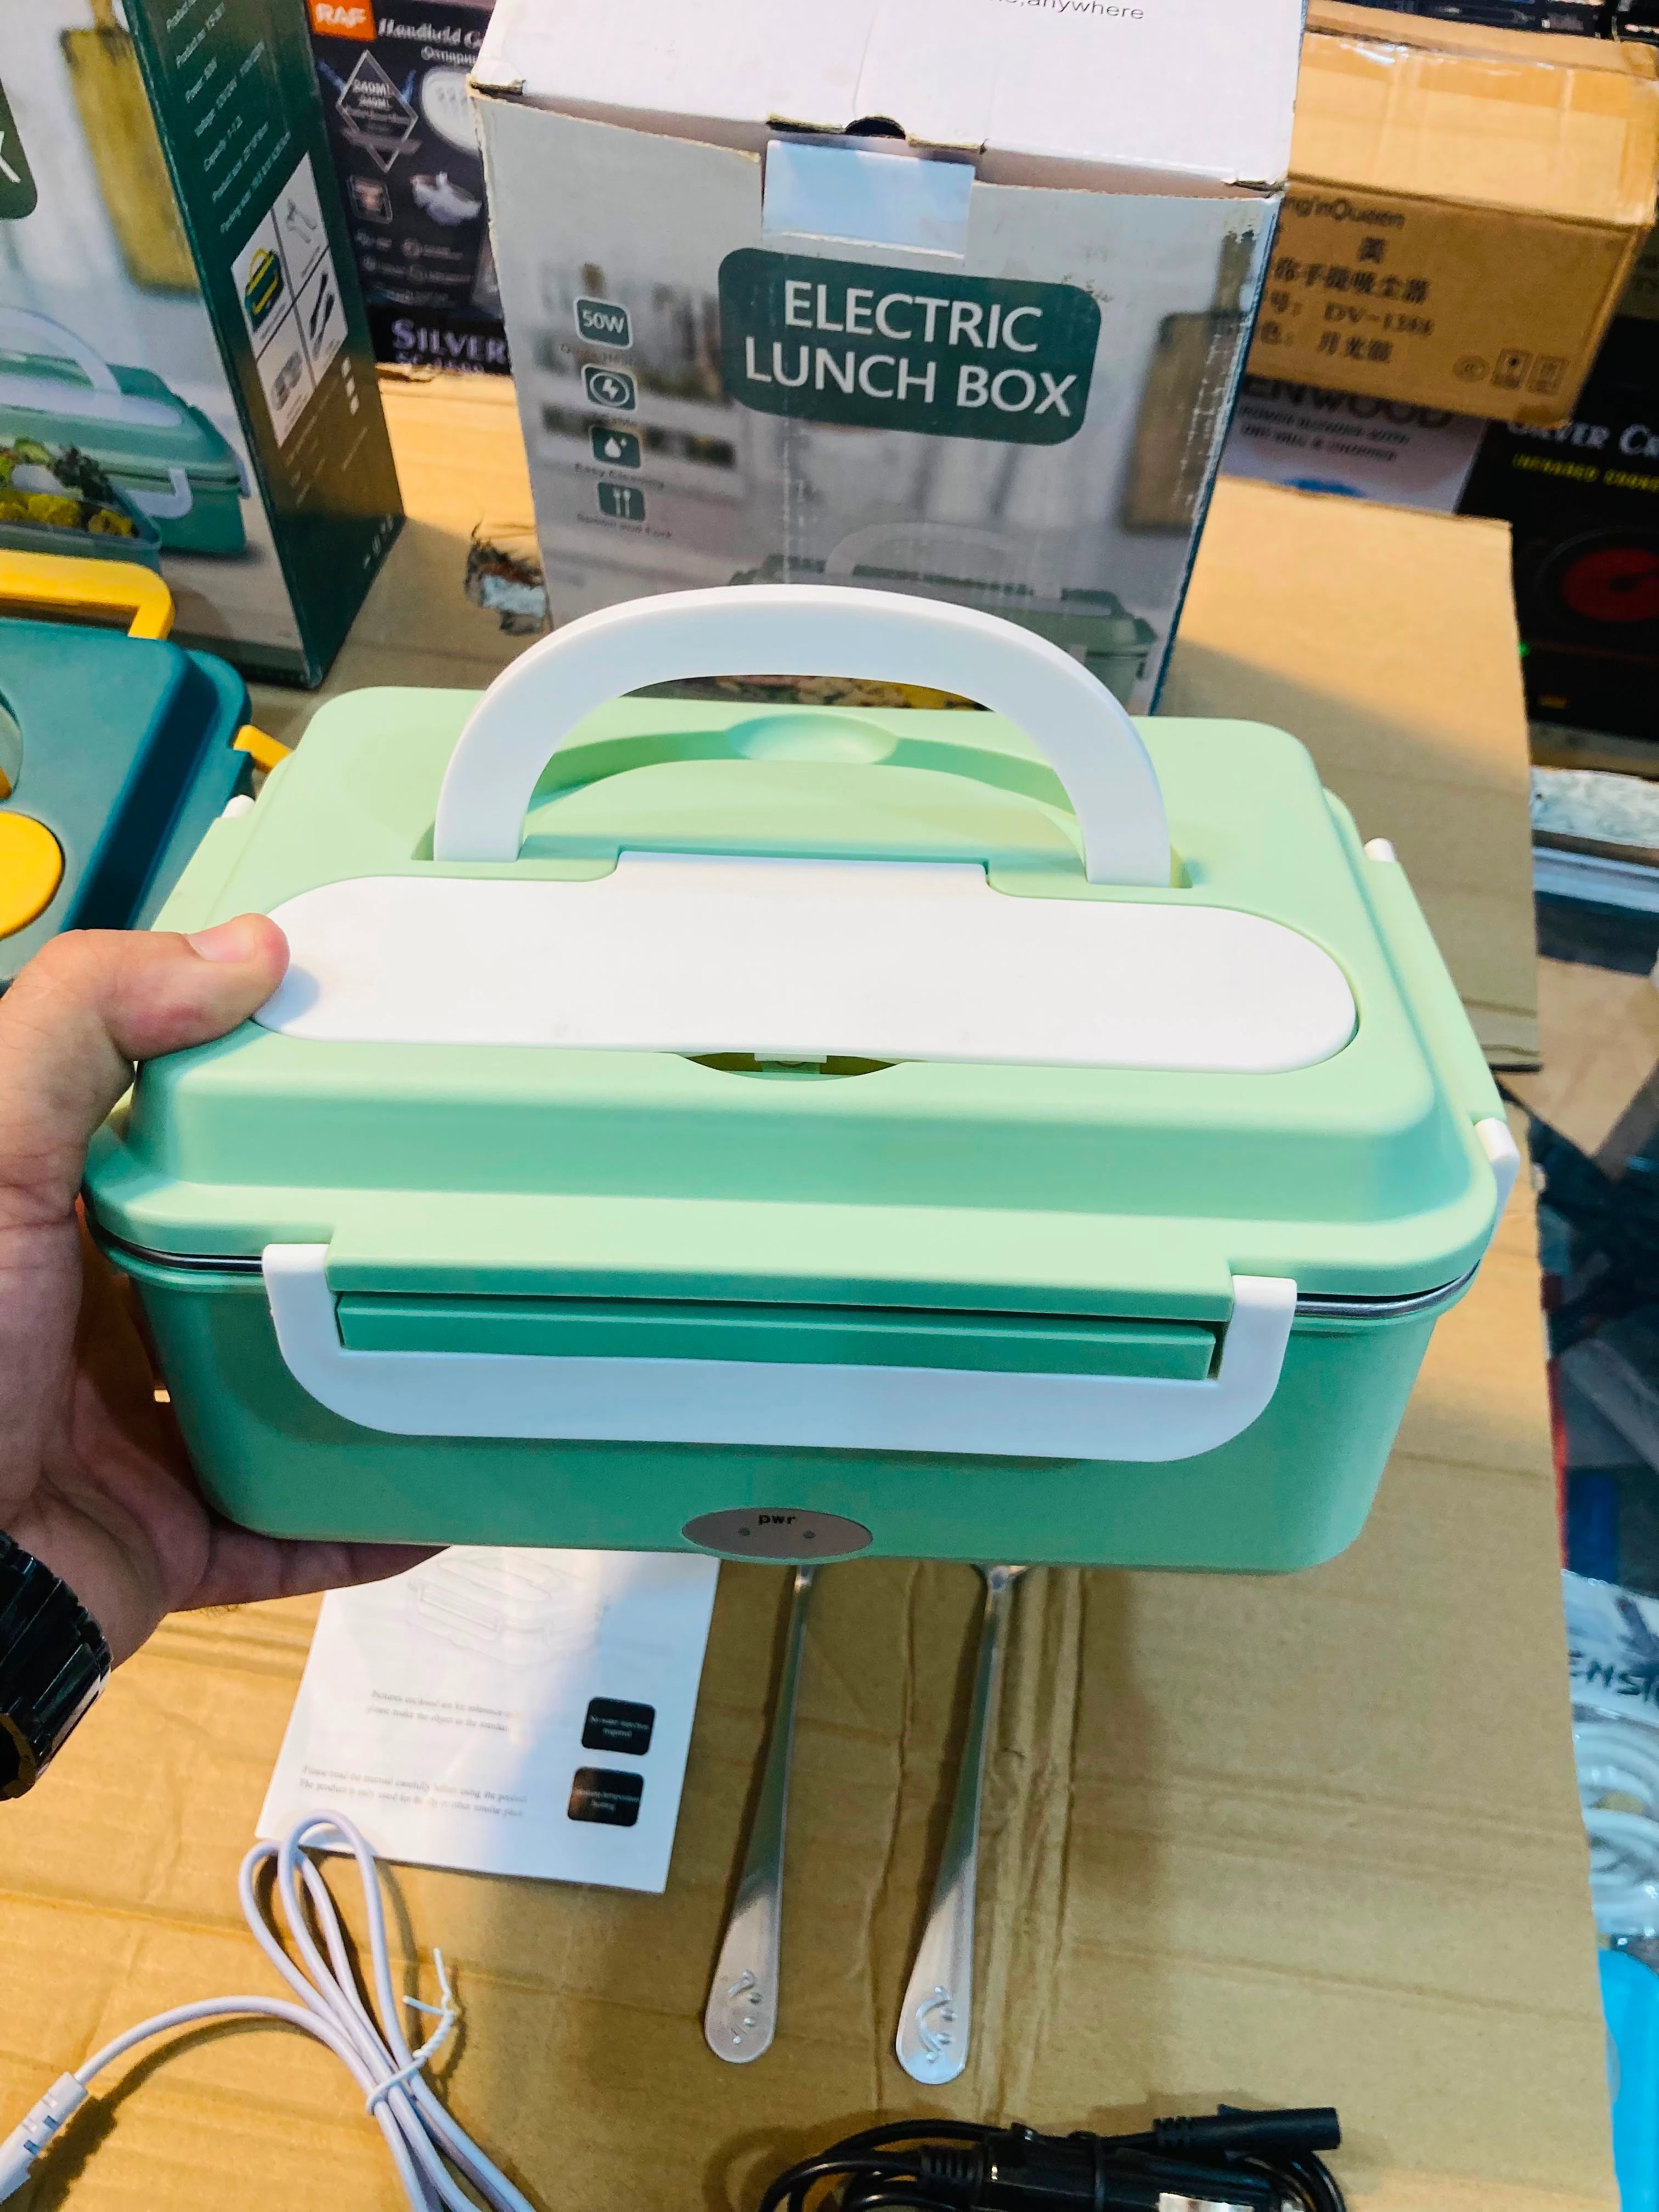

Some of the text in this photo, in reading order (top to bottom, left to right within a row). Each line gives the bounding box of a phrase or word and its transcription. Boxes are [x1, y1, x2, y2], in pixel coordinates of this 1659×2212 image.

[315, 3, 366, 28] RAF
[581, 308, 625, 334] 50W
[785, 279, 1042, 353] ELECTRIC
[745, 336, 1077, 418] LUNCH BOX
[758, 1514, 796, 1526] pwr
